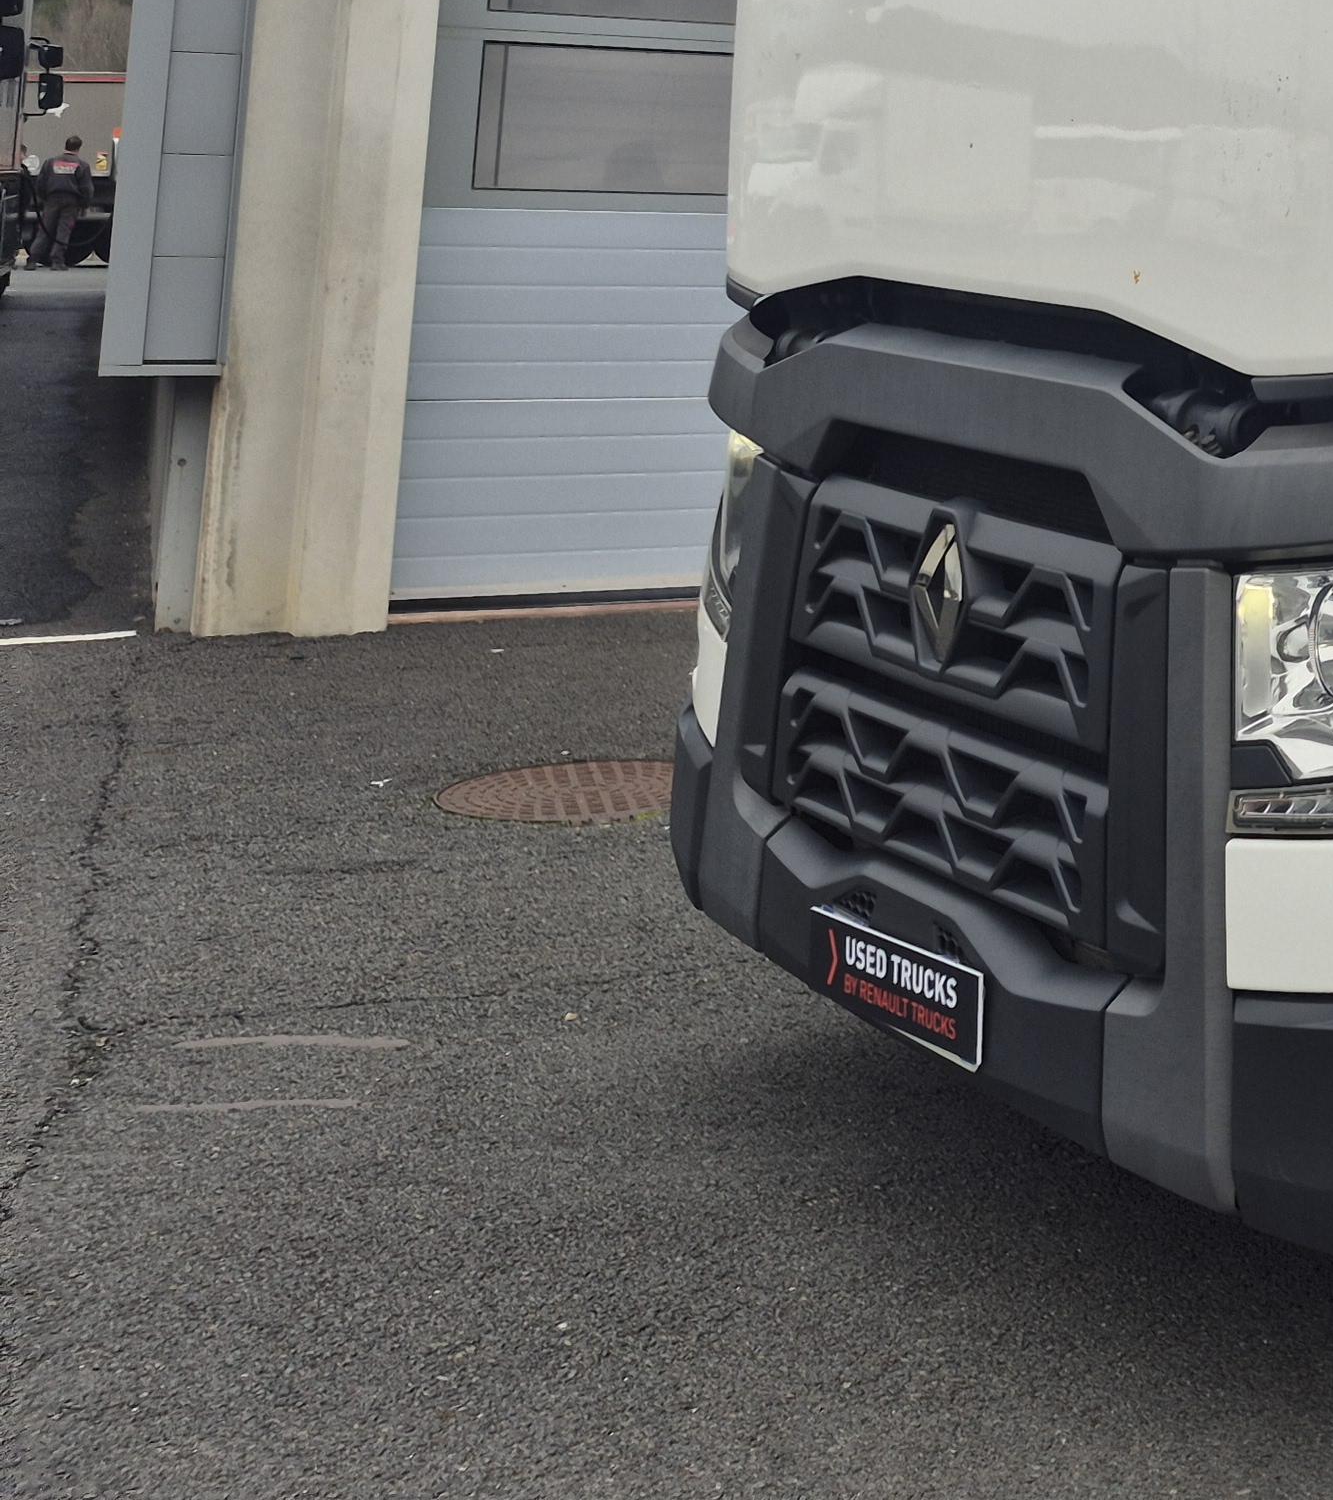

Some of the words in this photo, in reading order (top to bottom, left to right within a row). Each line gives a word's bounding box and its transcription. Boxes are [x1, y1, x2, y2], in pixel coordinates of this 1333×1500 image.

[843, 973, 858, 996] BY
[859, 979, 909, 1018] RENAULT
[911, 1001, 957, 1040] TRUCKS
[845, 936, 888, 979] USED
[890, 953, 958, 1009] TRUCKS
